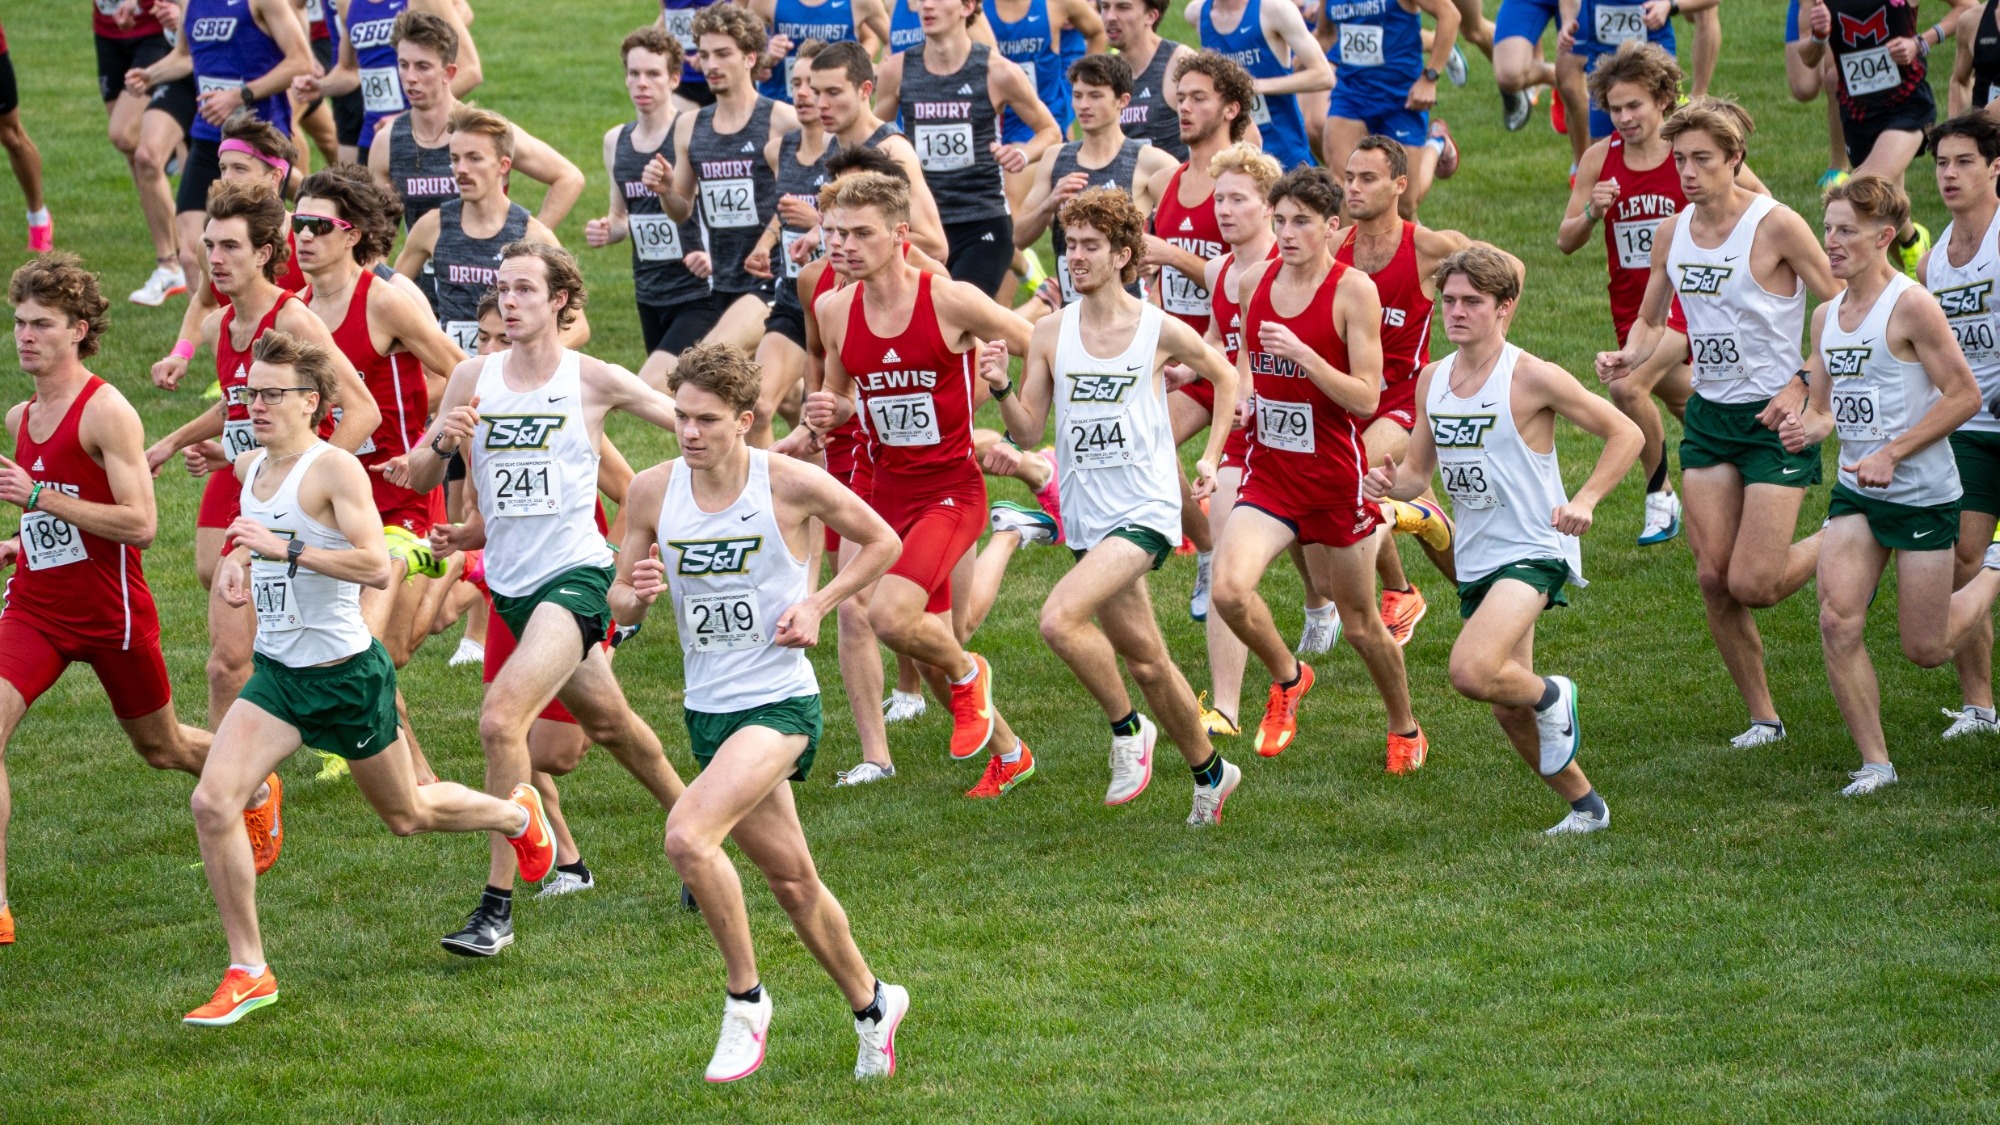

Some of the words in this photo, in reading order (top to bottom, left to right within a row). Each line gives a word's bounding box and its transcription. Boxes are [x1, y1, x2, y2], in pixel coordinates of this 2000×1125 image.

[193, 18, 236, 41] SBU
[352, 20, 394, 48] SBU
[1600, 12, 1642, 32] 276
[1343, 32, 1378, 54] 265
[1847, 54, 1891, 81] 204
[362, 76, 393, 97] 281
[914, 103, 971, 119] DRURY
[1120, 106, 1148, 123] RURY
[922, 133, 968, 156] 138
[701, 160, 753, 178] DRURY
[707, 188, 750, 213] 142
[1618, 194, 1676, 220] LEWIS
[636, 222, 673, 245] 139
[1622, 229, 1652, 253] 18
[1680, 266, 1730, 292] S&T
[1940, 283, 1990, 316] S&T
[453, 330, 478, 350] 14
[1694, 338, 1739, 364] 233
[1829, 349, 1870, 375] S&T
[855, 370, 936, 391] LEWIS
[1071, 375, 1135, 401] S&T
[877, 402, 930, 430] 175
[1261, 407, 1307, 436] 179
[1833, 396, 1874, 424] 239
[225, 429, 265, 455] 19
[484, 415, 562, 447] S&T
[1071, 422, 1126, 452] 244
[1433, 416, 1494, 445] S&T
[495, 467, 549, 498] 241
[1443, 467, 1487, 493] 243
[25, 518, 72, 551] 189
[676, 539, 759, 573] S&T
[253, 582, 287, 612] 217
[714, 594, 749, 602] CHAMPIONSHIPS
[692, 601, 753, 634] 219
